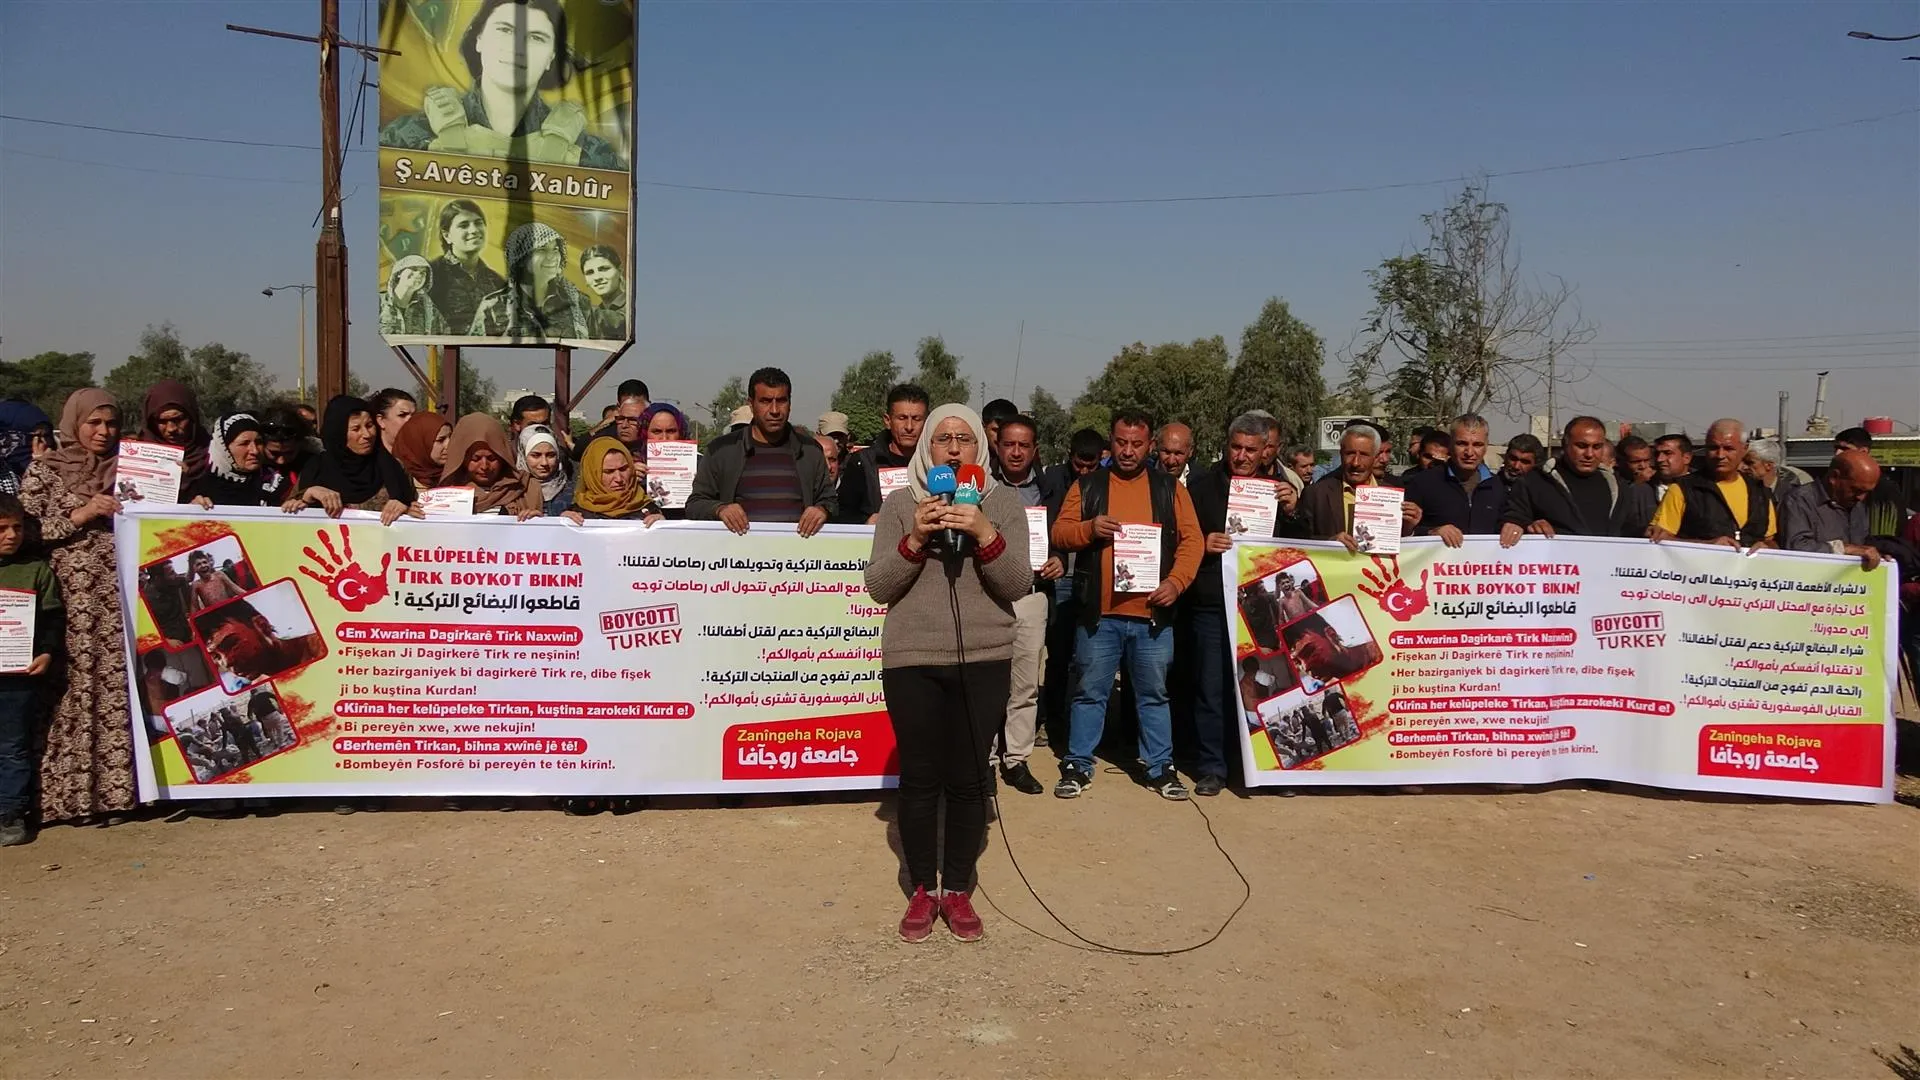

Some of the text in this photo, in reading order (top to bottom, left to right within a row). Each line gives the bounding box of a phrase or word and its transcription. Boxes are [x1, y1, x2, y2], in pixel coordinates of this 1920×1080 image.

[395, 158, 612, 199] Ş.Avêsta Xabûr
[397, 546, 582, 566] KELÛPELÊN DEWLETA
[663, 557, 821, 572] التركية وتحويلها رصاصات
[1433, 561, 1580, 576] KELÛPELÊN DEWLETA
[396, 568, 583, 587] TIRK BOYKOT BIKIN!
[1650, 570, 1793, 592] التركية وتحويلها رصاصات
[632, 580, 663, 592] توجه
[664, 580, 707, 593] رصاصات
[732, 580, 767, 594] تتحول
[769, 581, 803, 596] التركي
[806, 582, 843, 594] المحتل
[845, 584, 860, 596] مع
[1433, 582, 1580, 595] TIRK BOYKOT BIKIN!
[405, 591, 580, 614] قاطعوا البضائع التركية
[1621, 589, 1848, 615] تجارة المحتل التركي تتحول رصاصات توجه
[1442, 601, 1576, 619] قاطعوا البضائع التركية
[602, 607, 675, 630] BOYCOTT
[1594, 615, 1660, 632] BOYCOTT
[346, 628, 578, 642] Em Xwarina Dagirkarê Tirk Naxwin!
[607, 628, 682, 650] TURKEY
[749, 625, 879, 641] البضائع التركية دعم لقتل
[1397, 633, 1539, 646] Em Xwarina Dagirkarê Tirk
[1597, 634, 1666, 650] TURKEY
[1719, 636, 1864, 657] شراء البضائع التركية لقتل
[401, 648, 526, 660] Ji Dagirkerê Tirk re
[817, 646, 861, 663] أنفسكم
[1440, 650, 1528, 661] Ji Dagirkerê Tirk
[346, 665, 617, 680] Her bazirganiyek bi dagirkerê Tirk re, dibe
[1397, 666, 1603, 678] Her bazirganiyek bi dagirkerê dibe
[1780, 661, 1853, 676] تقتلوا أنفسكم
[750, 671, 798, 685] المنتجات
[801, 673, 817, 683] من
[820, 671, 849, 685] تفوح
[851, 670, 874, 684] الدم
[340, 684, 477, 697] ji bo kuştina Kurdan!
[1393, 683, 1500, 696] ji bo kuştina Kurdan!
[1719, 677, 1862, 698] رائحة الدم تفوح المنتجات
[799, 692, 864, 706] الفوسفورية
[1396, 699, 1670, 713] Kirîna her kelûpeleke Tirkan, Kurd e!
[344, 702, 688, 718] Kirîna her kelûpeleke Tirkan, kuştina Kurd e!
[1761, 703, 1862, 717] القنابل الفوسفورية
[344, 722, 535, 735] Bi pereyên xwe, xwe nekujin!
[1396, 718, 1406, 726] Bi
[1410, 717, 1450, 728] pereyên
[1454, 717, 1479, 726] xwe,
[737, 728, 862, 743] Zanîngeha Rojava
[1395, 732, 1524, 743] Berhemên Tirkan, bihna
[1709, 730, 1821, 748] Zanîngeha Rojava
[343, 740, 578, 753] Berhemên Tirkan, bihna xwînê jê tê!
[801, 745, 859, 767] جامعة
[1396, 748, 1507, 760] Bombeyên Fosforê bi
[343, 758, 576, 771] Bombeyên Fosforê bi pereyên te tên
[1763, 751, 1819, 774] جامعة
